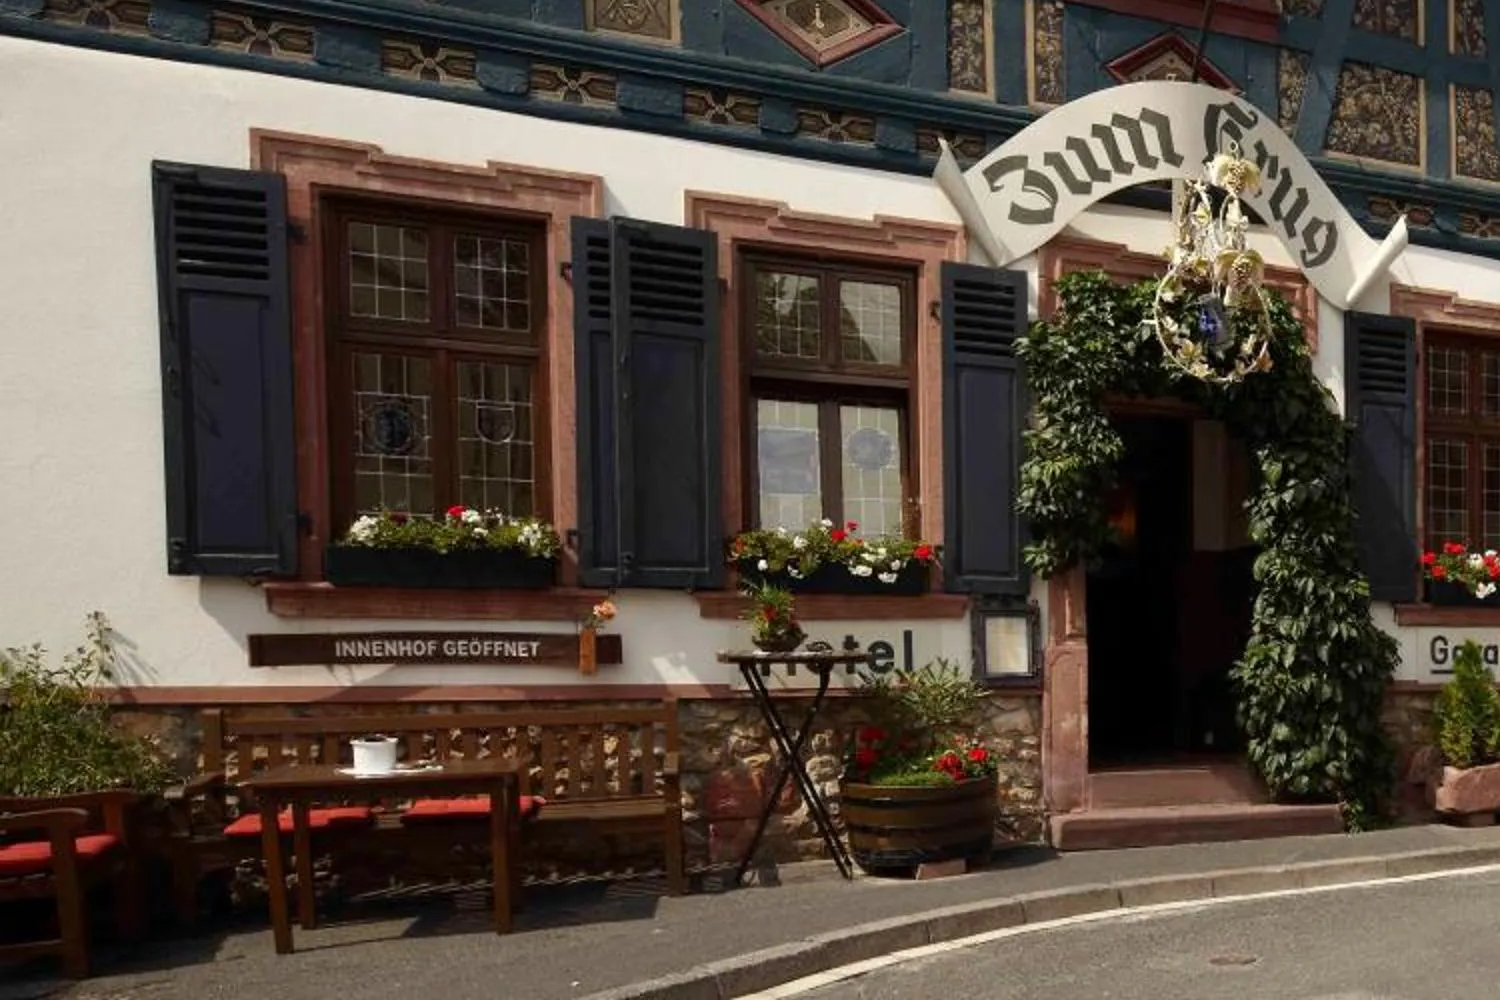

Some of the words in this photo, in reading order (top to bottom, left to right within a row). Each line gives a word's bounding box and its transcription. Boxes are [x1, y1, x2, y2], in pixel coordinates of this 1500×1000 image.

[982, 107, 1184, 225] Zum
[335, 639, 438, 658] INNENHOF
[442, 638, 540, 658] GEÖFFNET
[760, 629, 914, 677] otel
